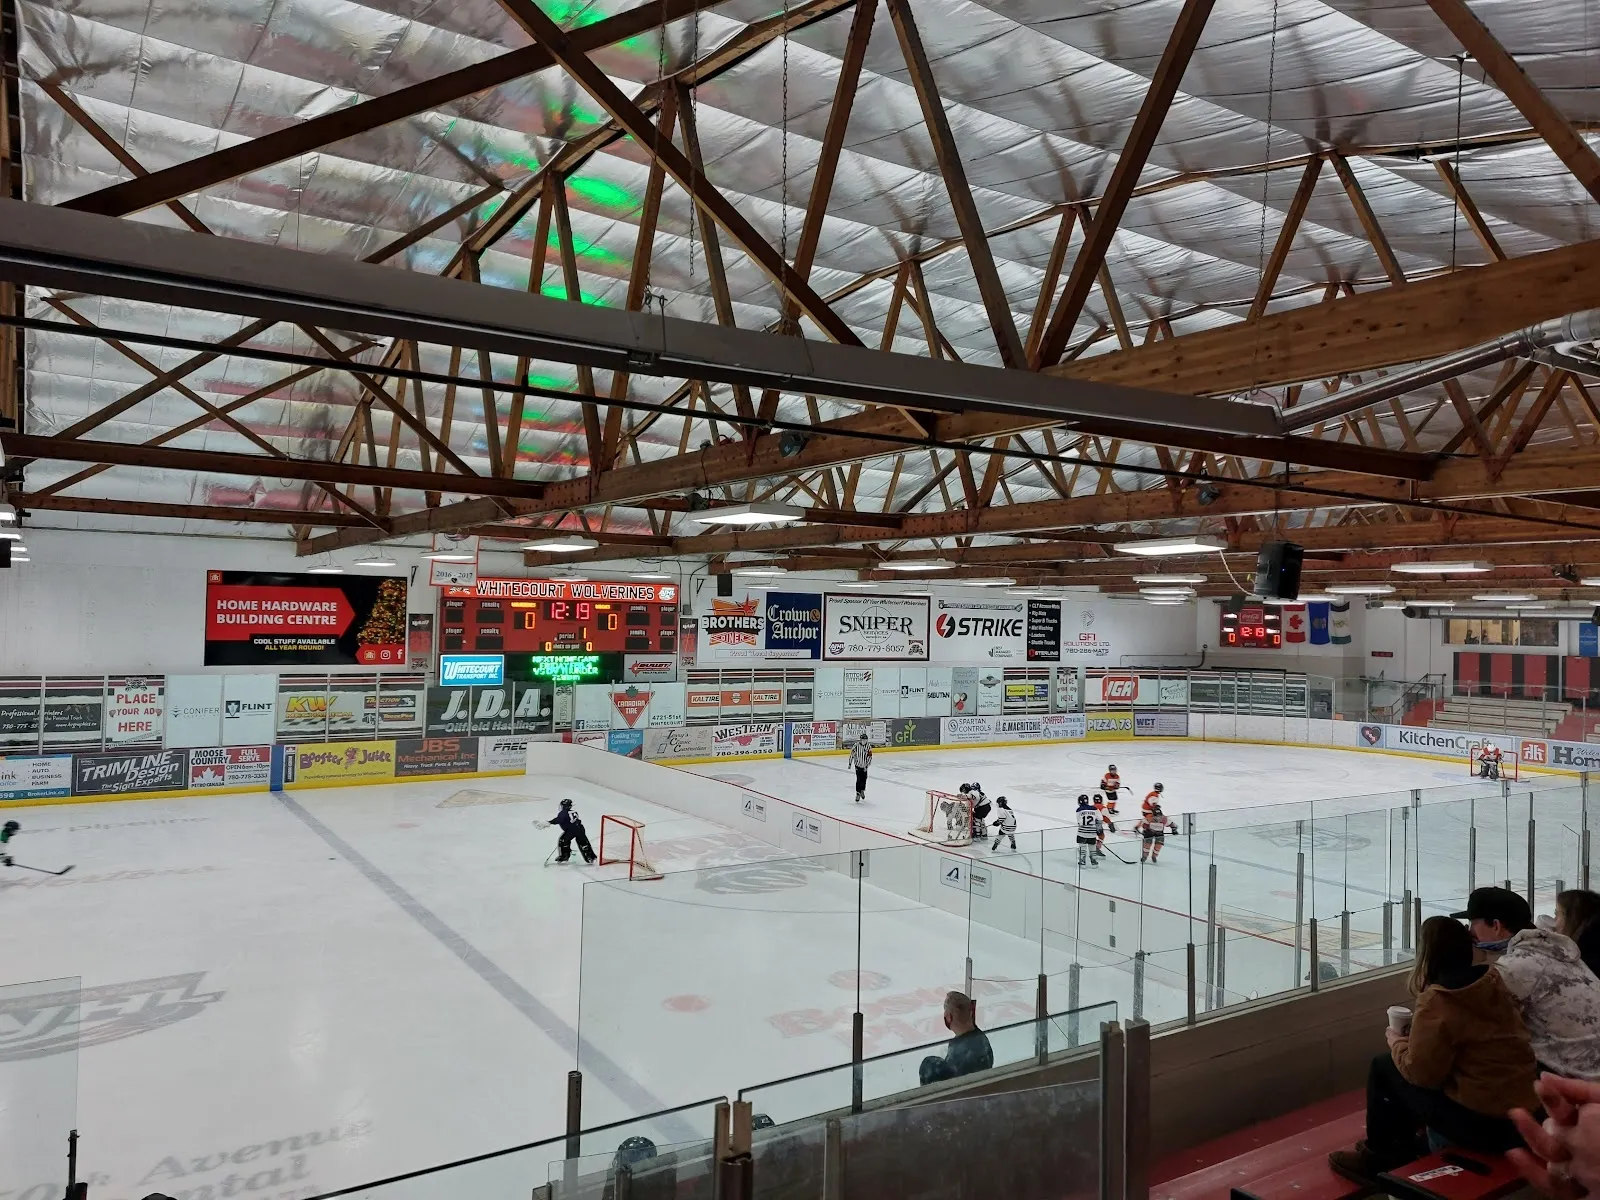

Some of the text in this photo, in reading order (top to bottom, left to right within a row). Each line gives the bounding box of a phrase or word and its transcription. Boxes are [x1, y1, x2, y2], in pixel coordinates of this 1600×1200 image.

[476, 580, 655, 600] WHITECOURT WOLVERINES
[217, 600, 337, 612] HOME HARDWARE
[551, 602, 590, 619] 12:19
[767, 604, 810, 622] Crown
[217, 614, 337, 625] BUILDING CENTRE
[525, 612, 536, 629] 0
[608, 613, 617, 630] 0
[702, 616, 764, 629] BROTHERS
[839, 615, 914, 636] SNIPER
[958, 618, 1024, 637] STRIKE
[772, 622, 819, 642] Anchor
[545, 642, 552, 651] 0
[586, 641, 593, 651] 0
[443, 662, 502, 680] WHITECOURT
[1104, 681, 1135, 696] IGA
[117, 694, 156, 703] PLACE
[285, 696, 338, 712] KW
[118, 721, 152, 732] HERE
[715, 724, 771, 740] WESTERN
[1087, 720, 1118, 731] PIZZA
[1120, 719, 1132, 730] 73
[895, 729, 915, 743] GFL
[415, 739, 460, 753] JBS
[191, 757, 229, 765] COUNTRY
[300, 752, 343, 769] Booster
[358, 750, 391, 764] Juice
[398, 753, 457, 762] Mechanical
[82, 751, 173, 782] TRIMLINE
[125, 762, 179, 782] Design
[111, 782, 134, 792] Sign
[135, 774, 172, 787] Experts
[1082, 815, 1094, 826] 12
